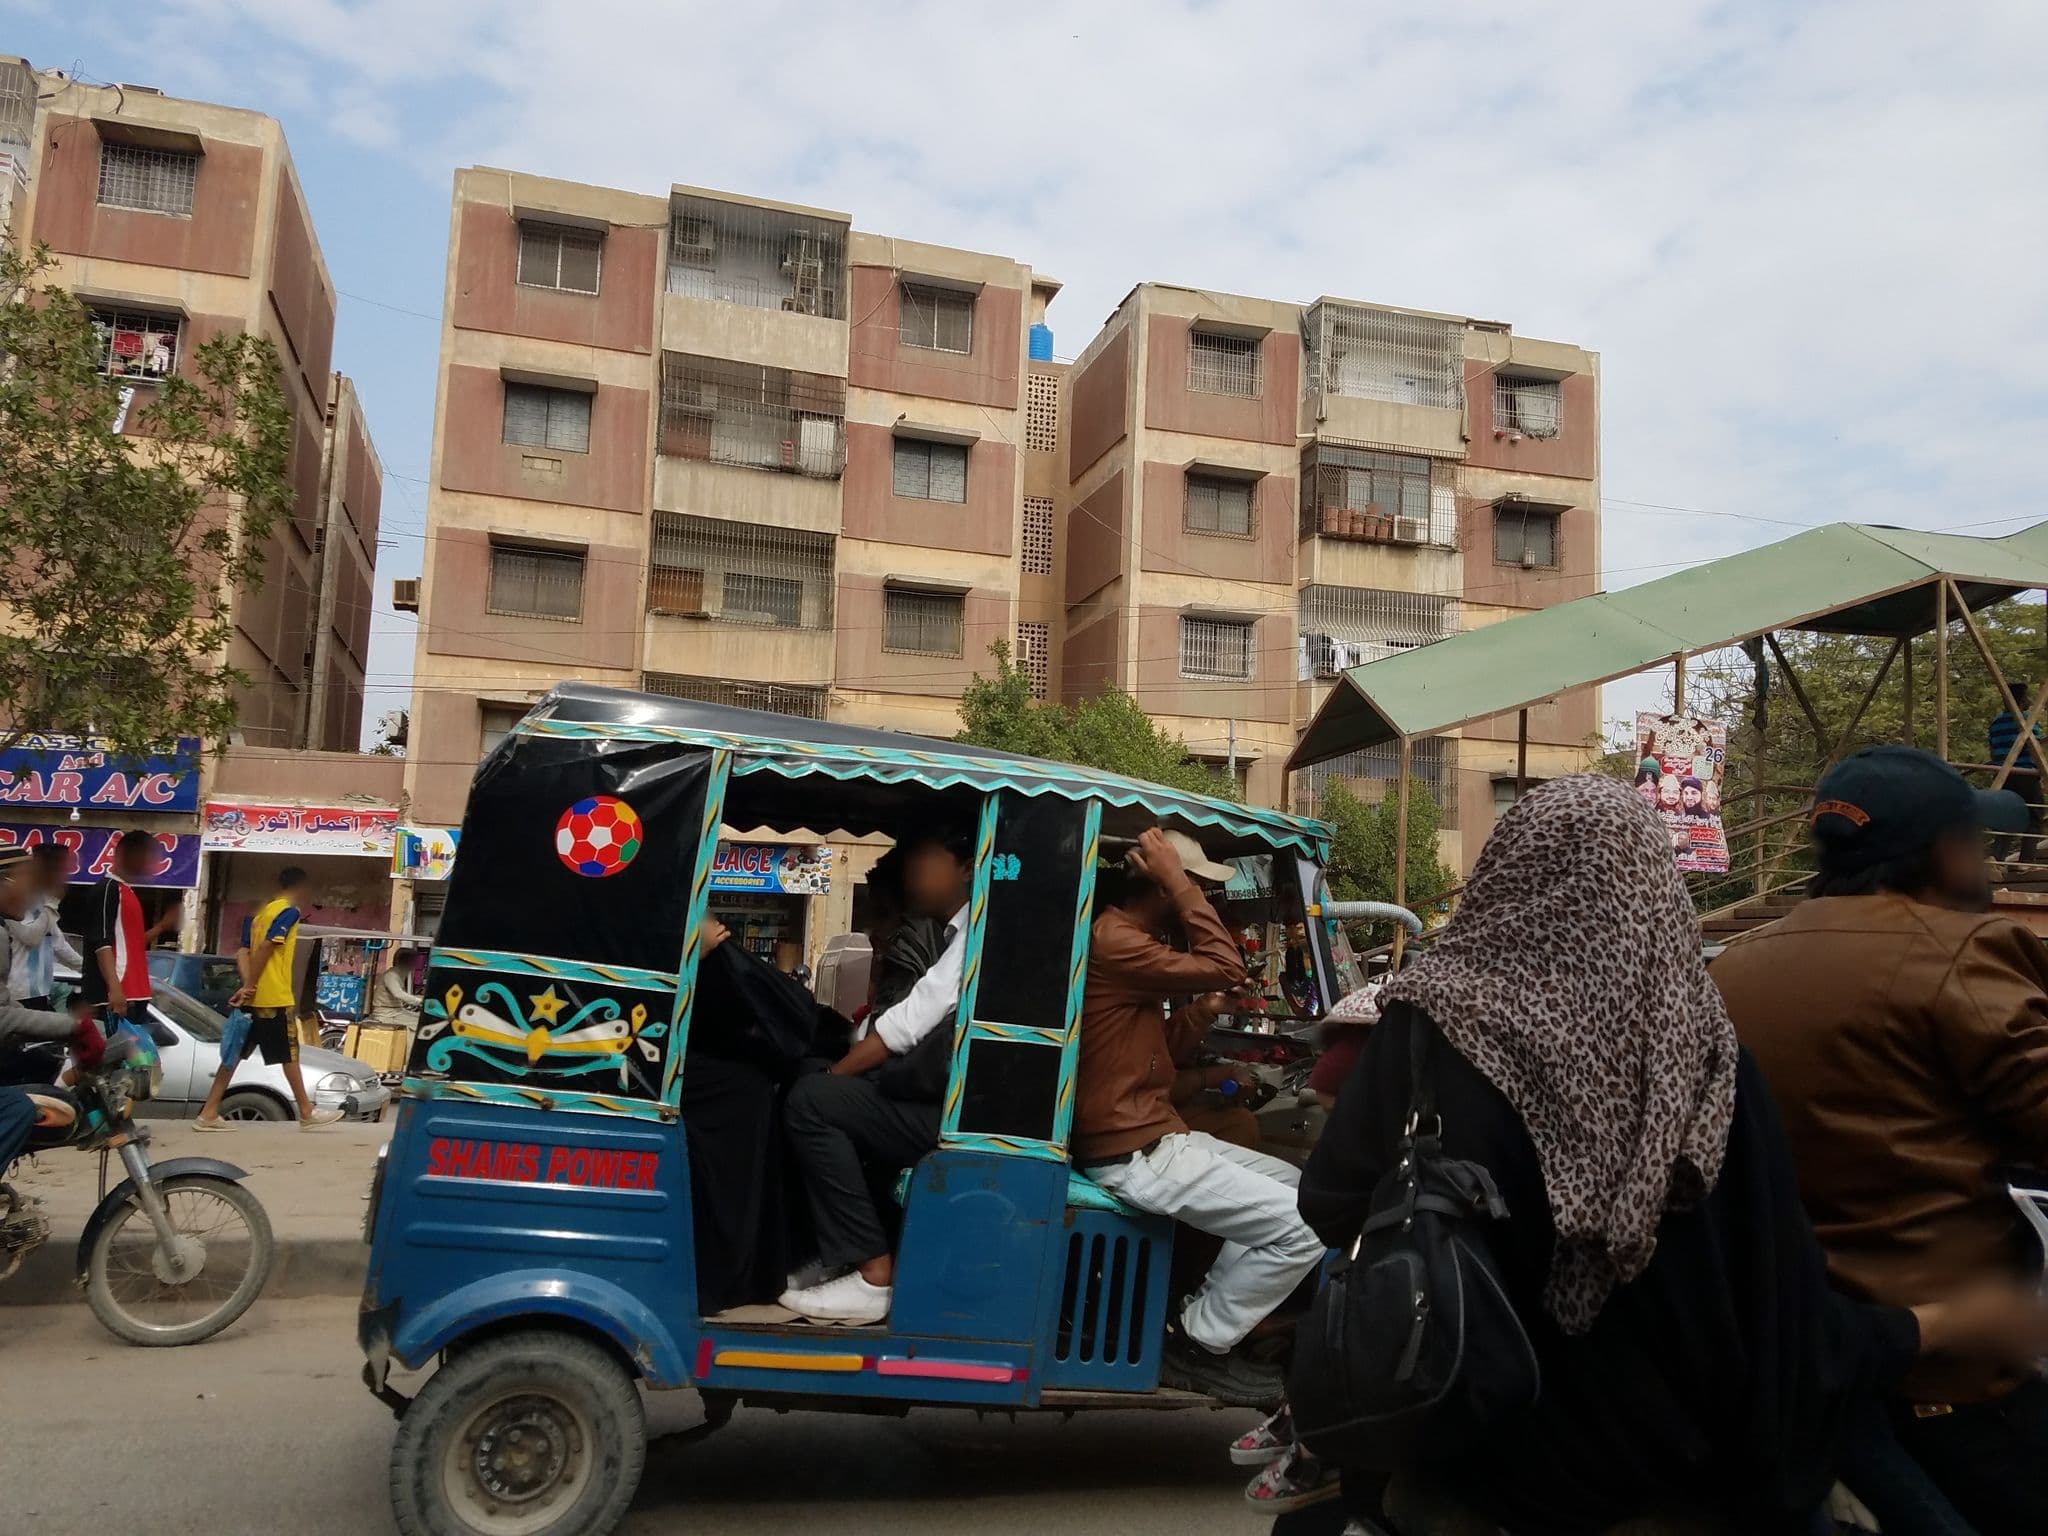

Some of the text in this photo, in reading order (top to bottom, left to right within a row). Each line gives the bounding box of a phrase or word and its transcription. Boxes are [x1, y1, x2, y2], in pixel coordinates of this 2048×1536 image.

[58, 752, 105, 771] And
[1705, 747, 1725, 763] 26
[90, 772, 181, 806] A/C
[426, 1137, 659, 1191] SHAMS POWER
